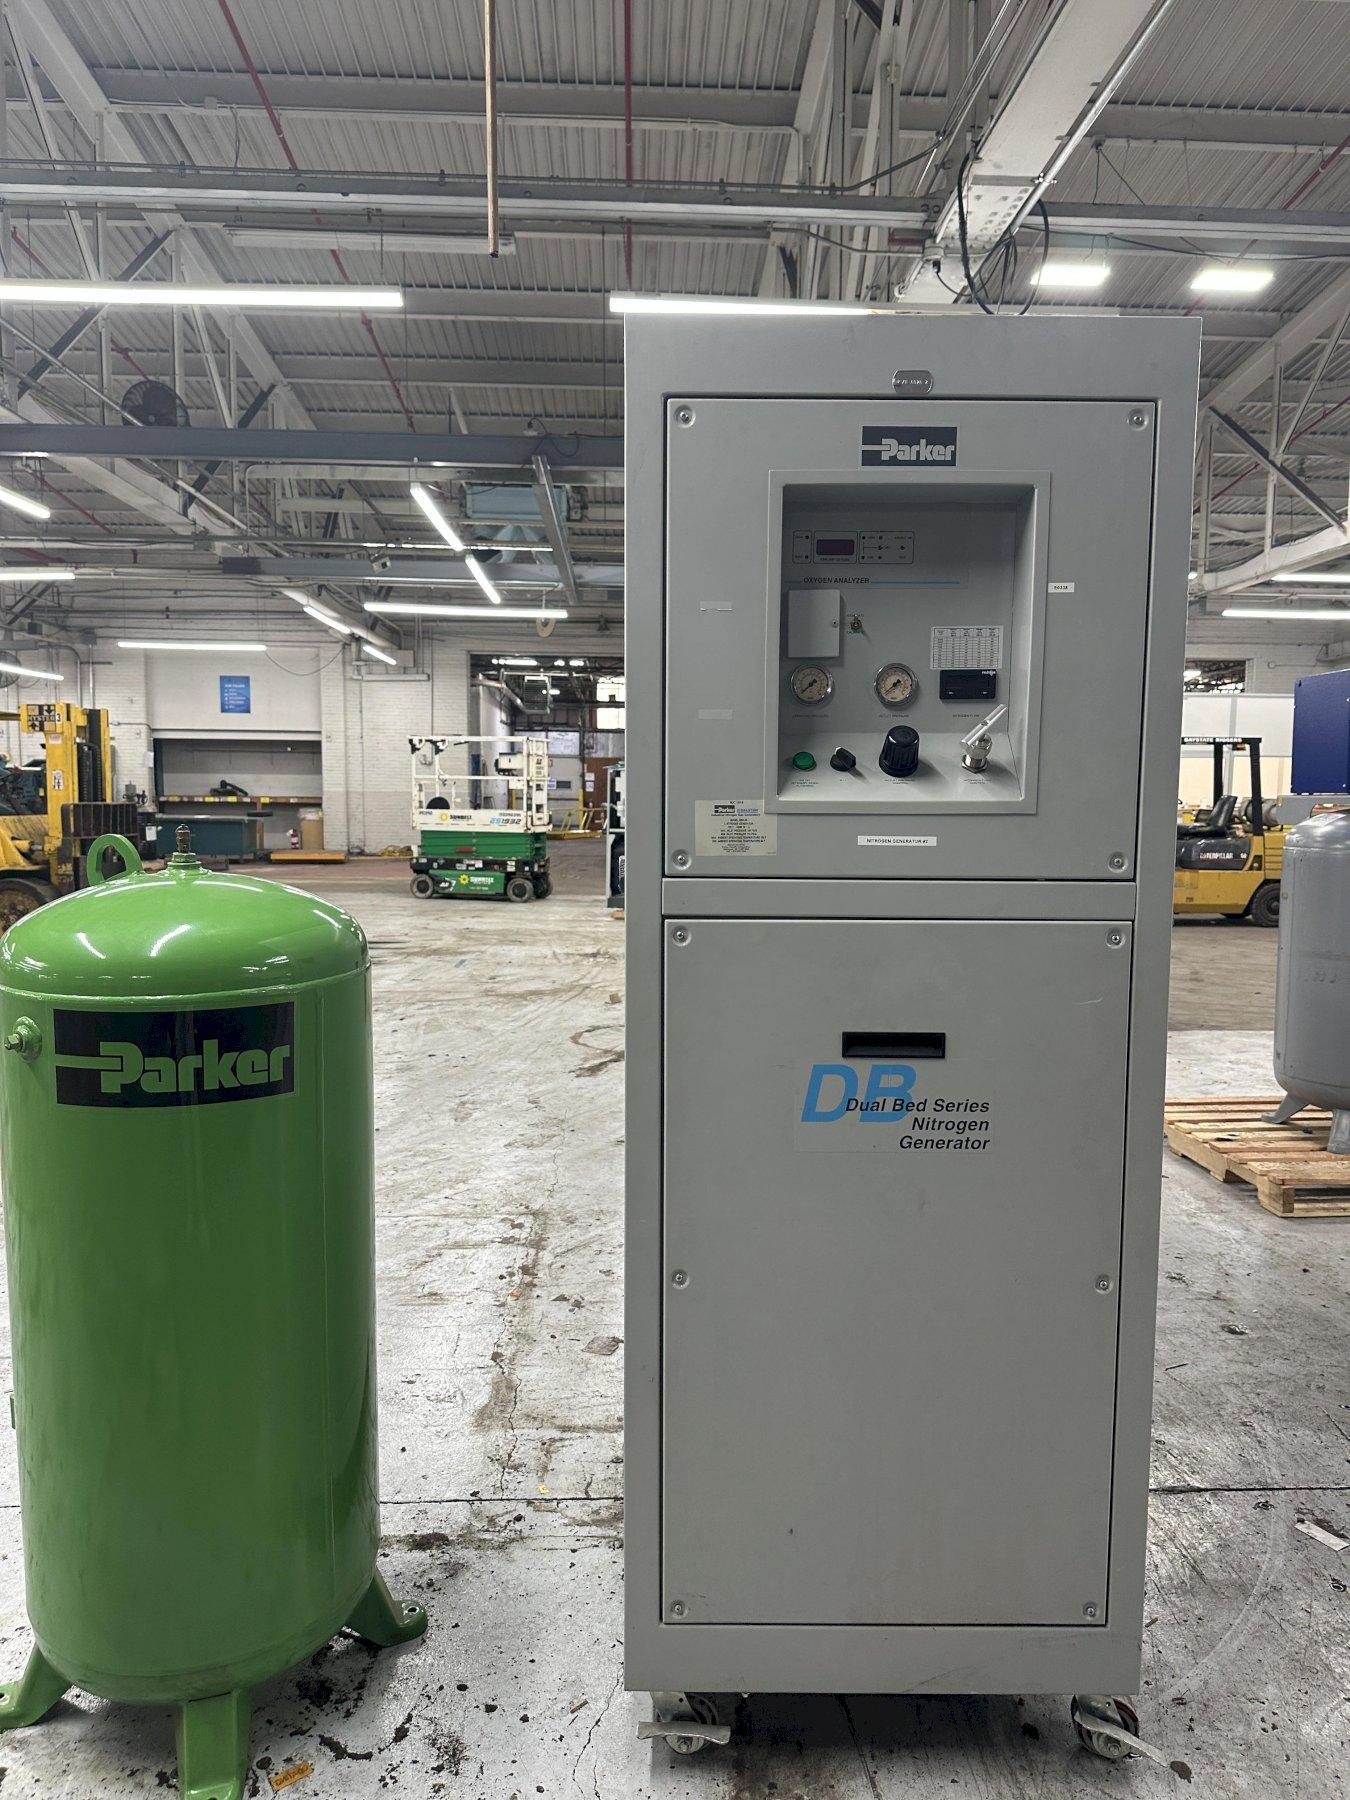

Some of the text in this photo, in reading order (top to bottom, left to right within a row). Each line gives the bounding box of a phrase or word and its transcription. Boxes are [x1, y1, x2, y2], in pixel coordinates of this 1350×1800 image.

[881, 438, 955, 461] Parker
[99, 1039, 291, 1094] Parker
[801, 1063, 917, 1123] DB
[845, 1098, 991, 1113] Dual Bed Series
[911, 1117, 990, 1135] Nitrogen
[899, 1135, 991, 1151] Generator
